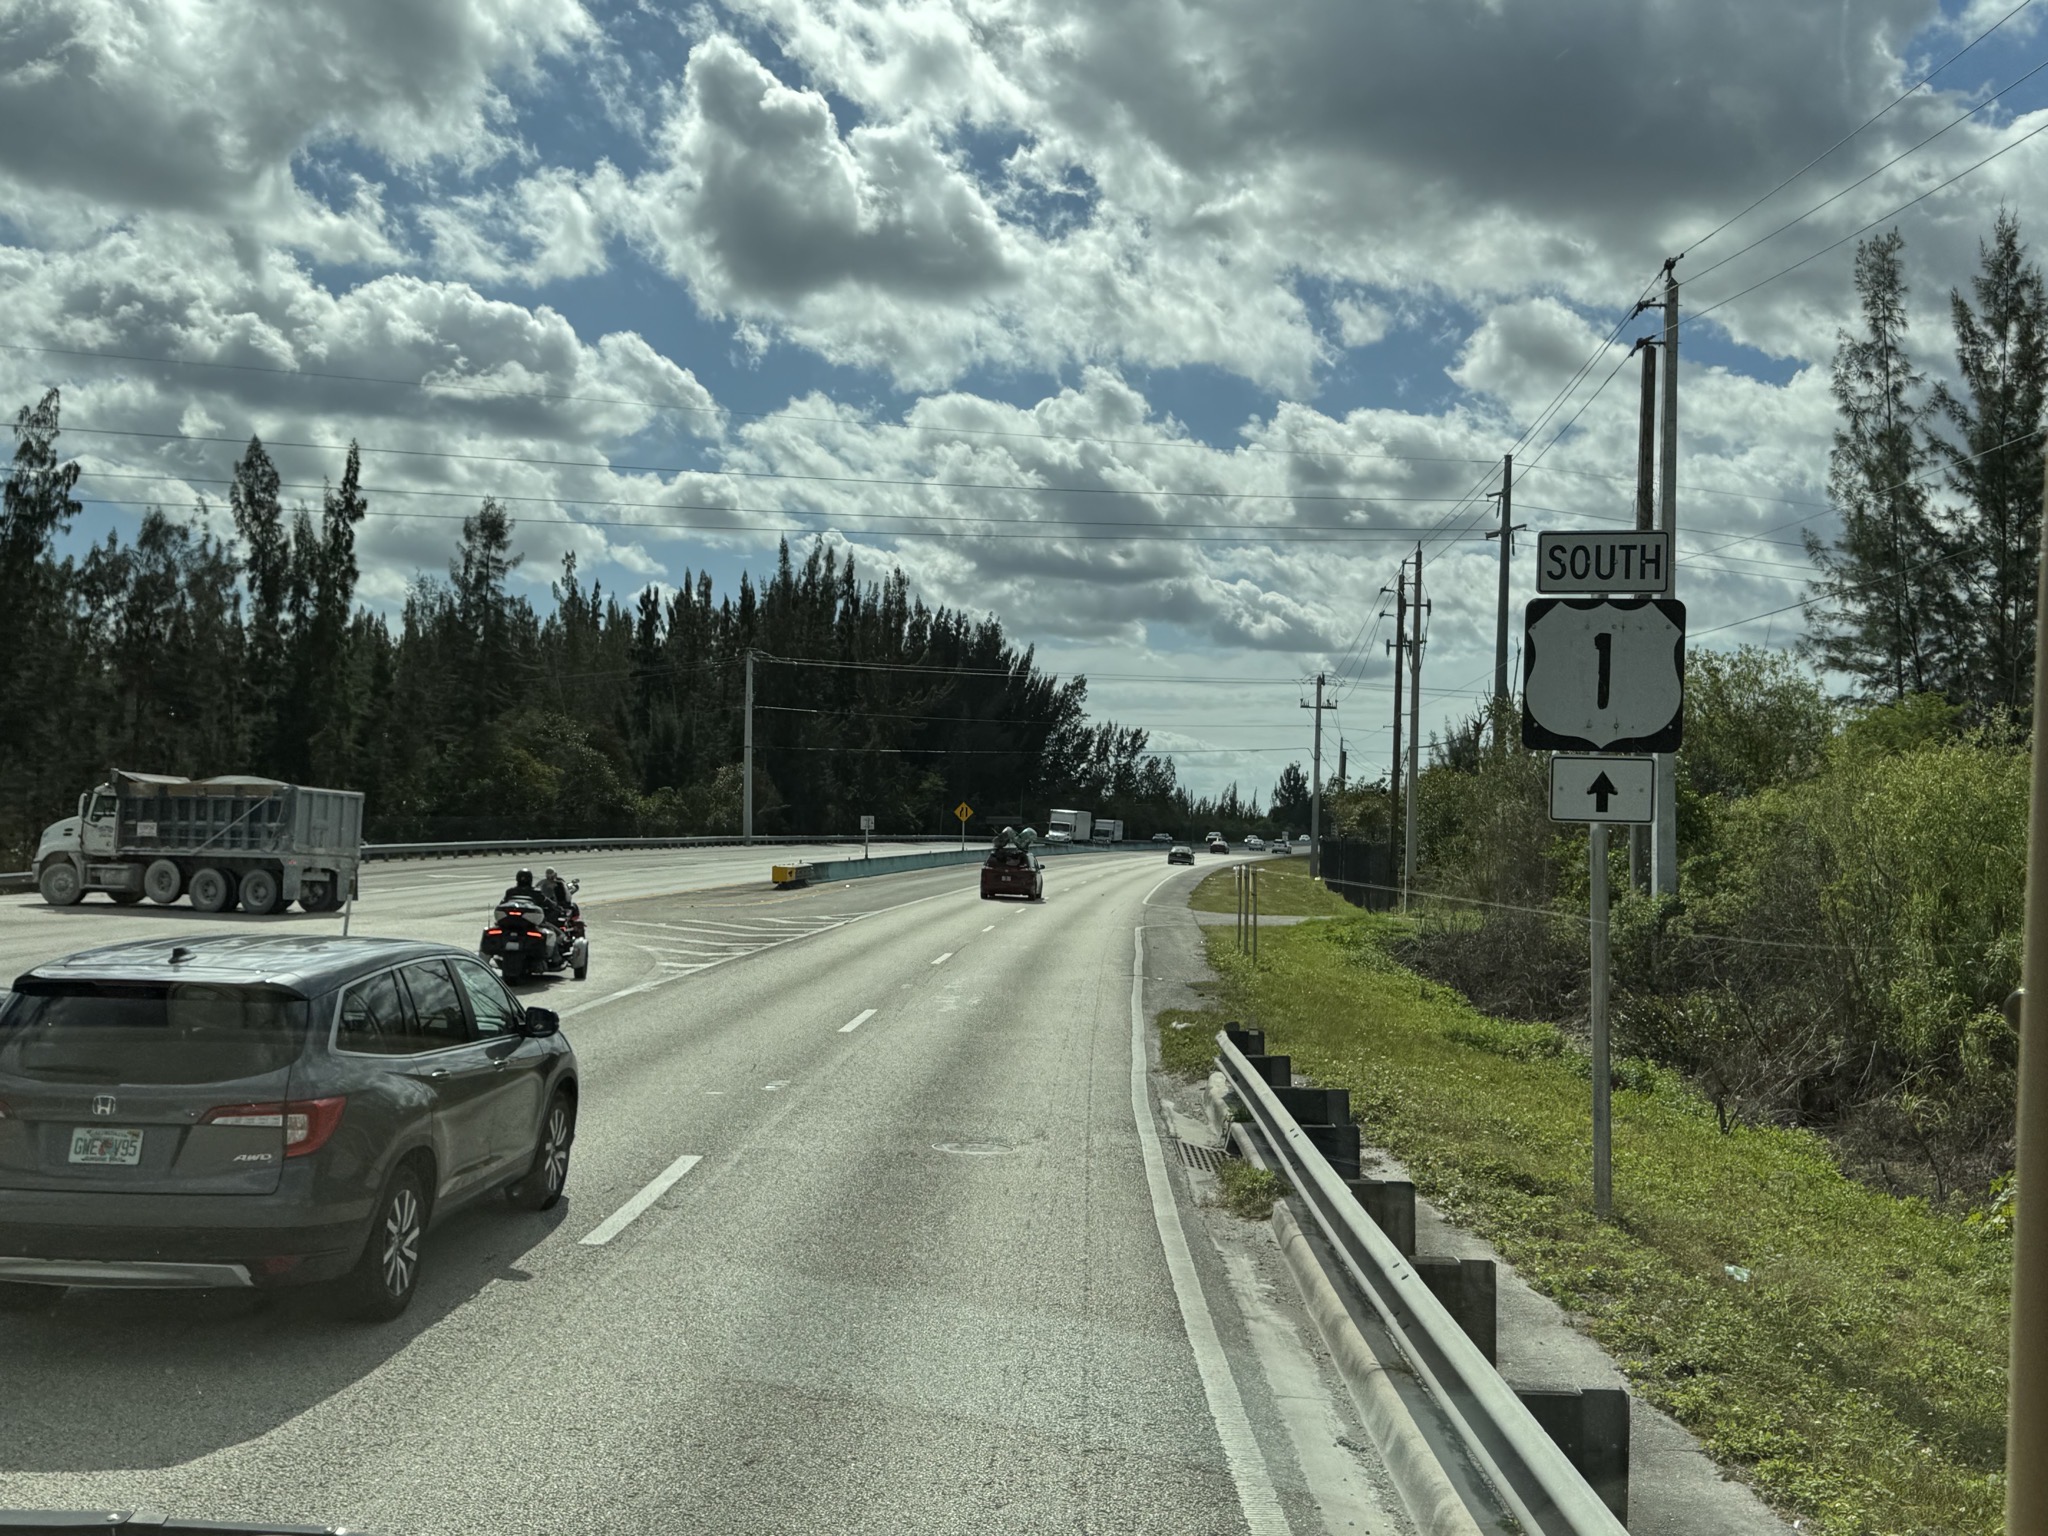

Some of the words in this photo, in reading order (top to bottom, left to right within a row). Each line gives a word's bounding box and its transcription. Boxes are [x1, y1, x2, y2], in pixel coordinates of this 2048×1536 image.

[1546, 544, 1661, 580] SOUTH
[1594, 632, 1612, 710] 1
[232, 1153, 273, 1162] AWD
